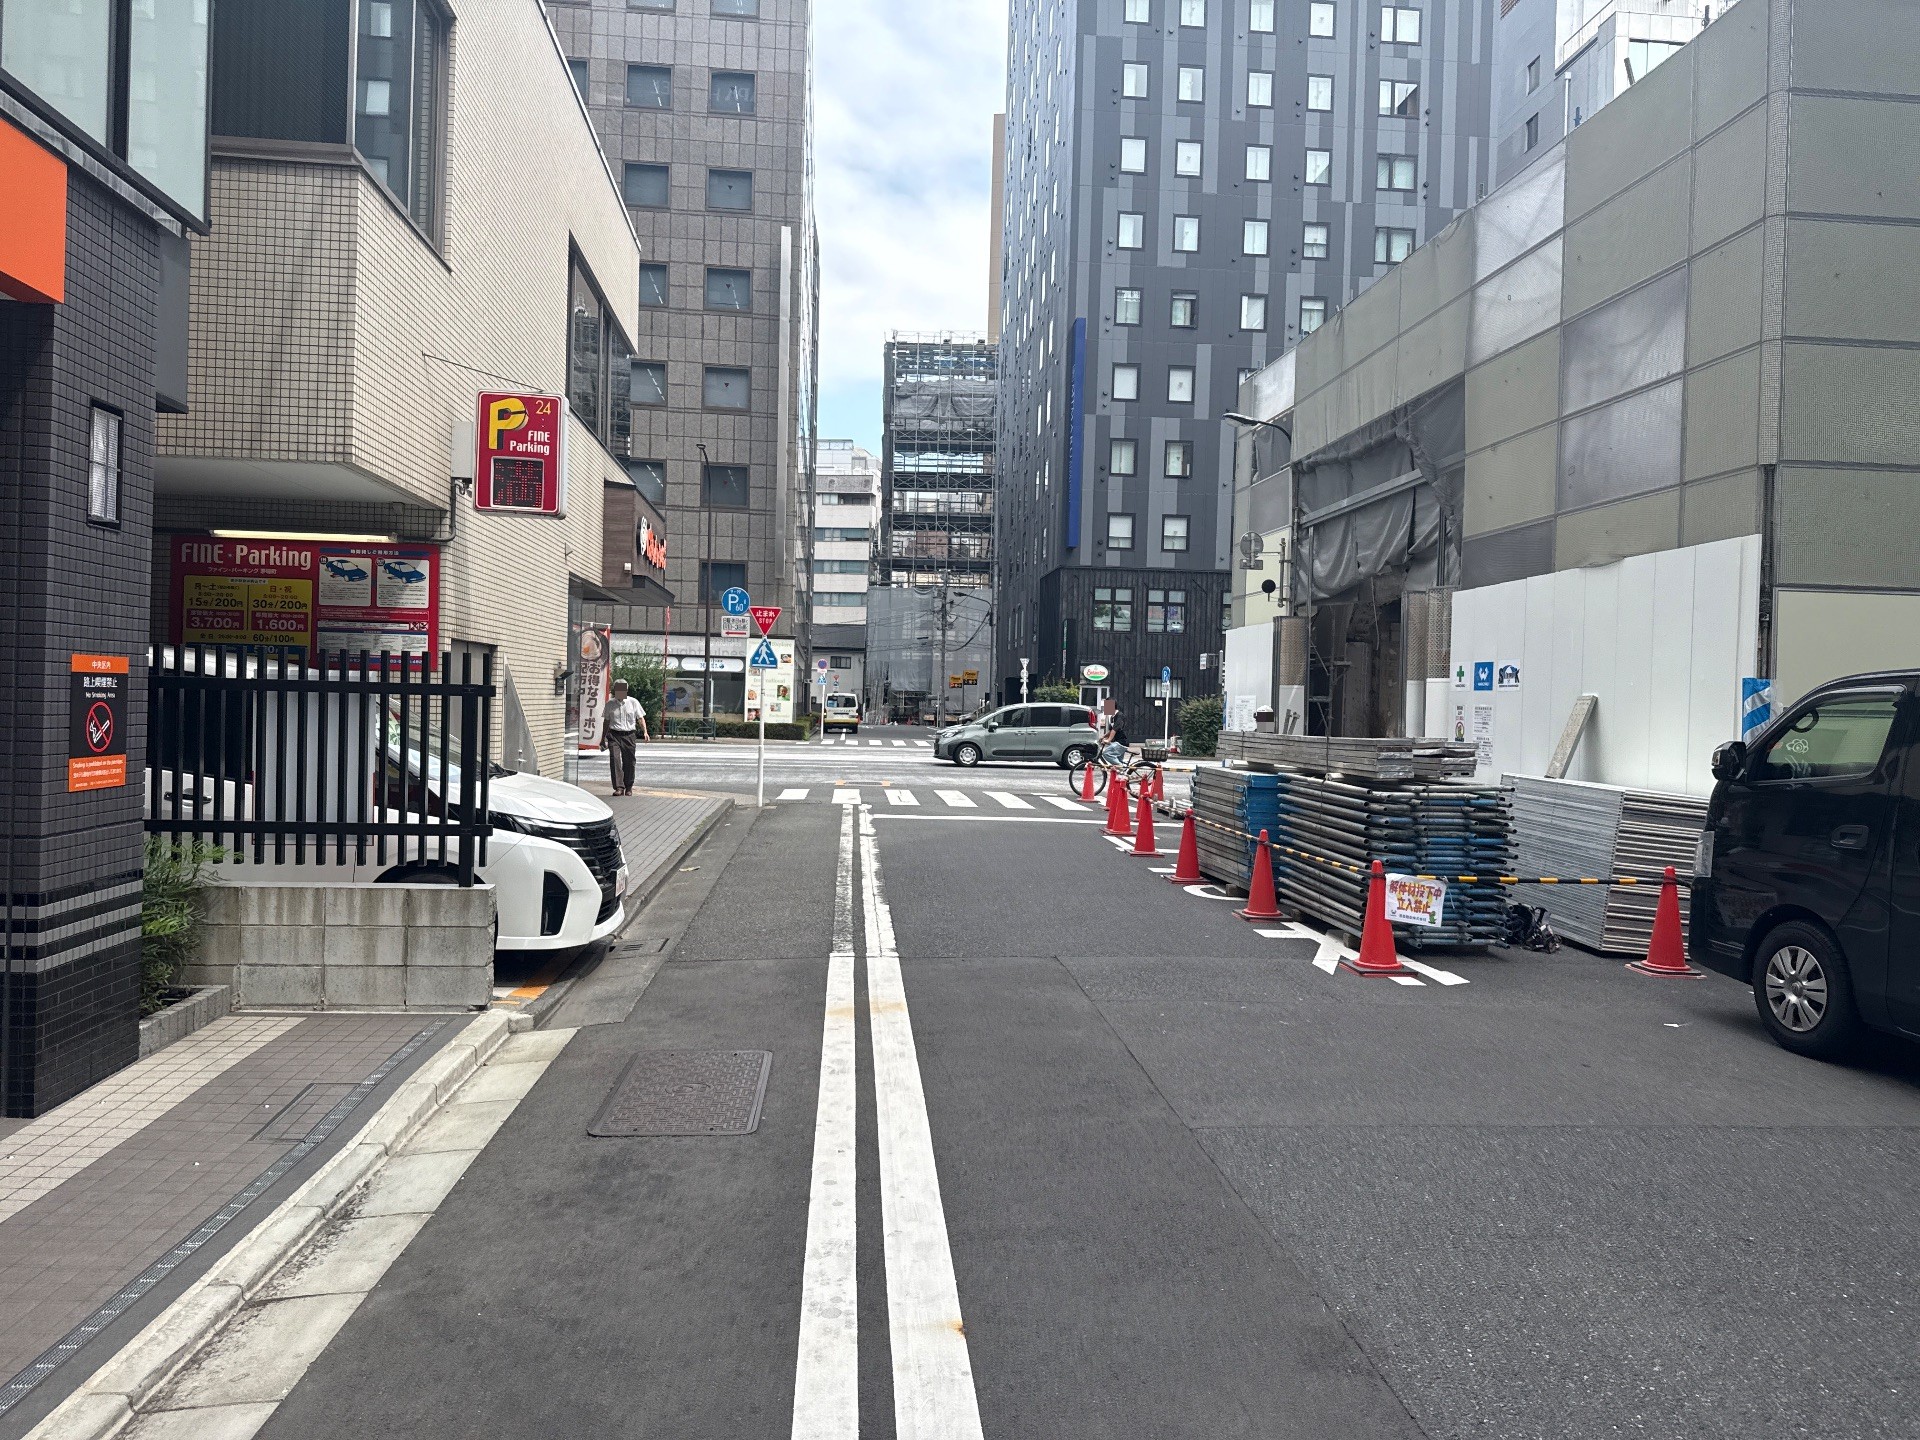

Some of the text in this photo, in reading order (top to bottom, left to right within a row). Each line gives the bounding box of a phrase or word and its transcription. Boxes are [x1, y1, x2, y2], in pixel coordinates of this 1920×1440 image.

[536, 400, 551, 415] 24
[528, 430, 550, 443] FINE
[509, 440, 550, 456] Parking
[181, 543, 312, 571] FINE Parking
[728, 593, 739, 611] P
[755, 609, 776, 618] 止まれ
[583, 662, 601, 740] お得なクーポン
[1396, 897, 1432, 915] 立入禁止
